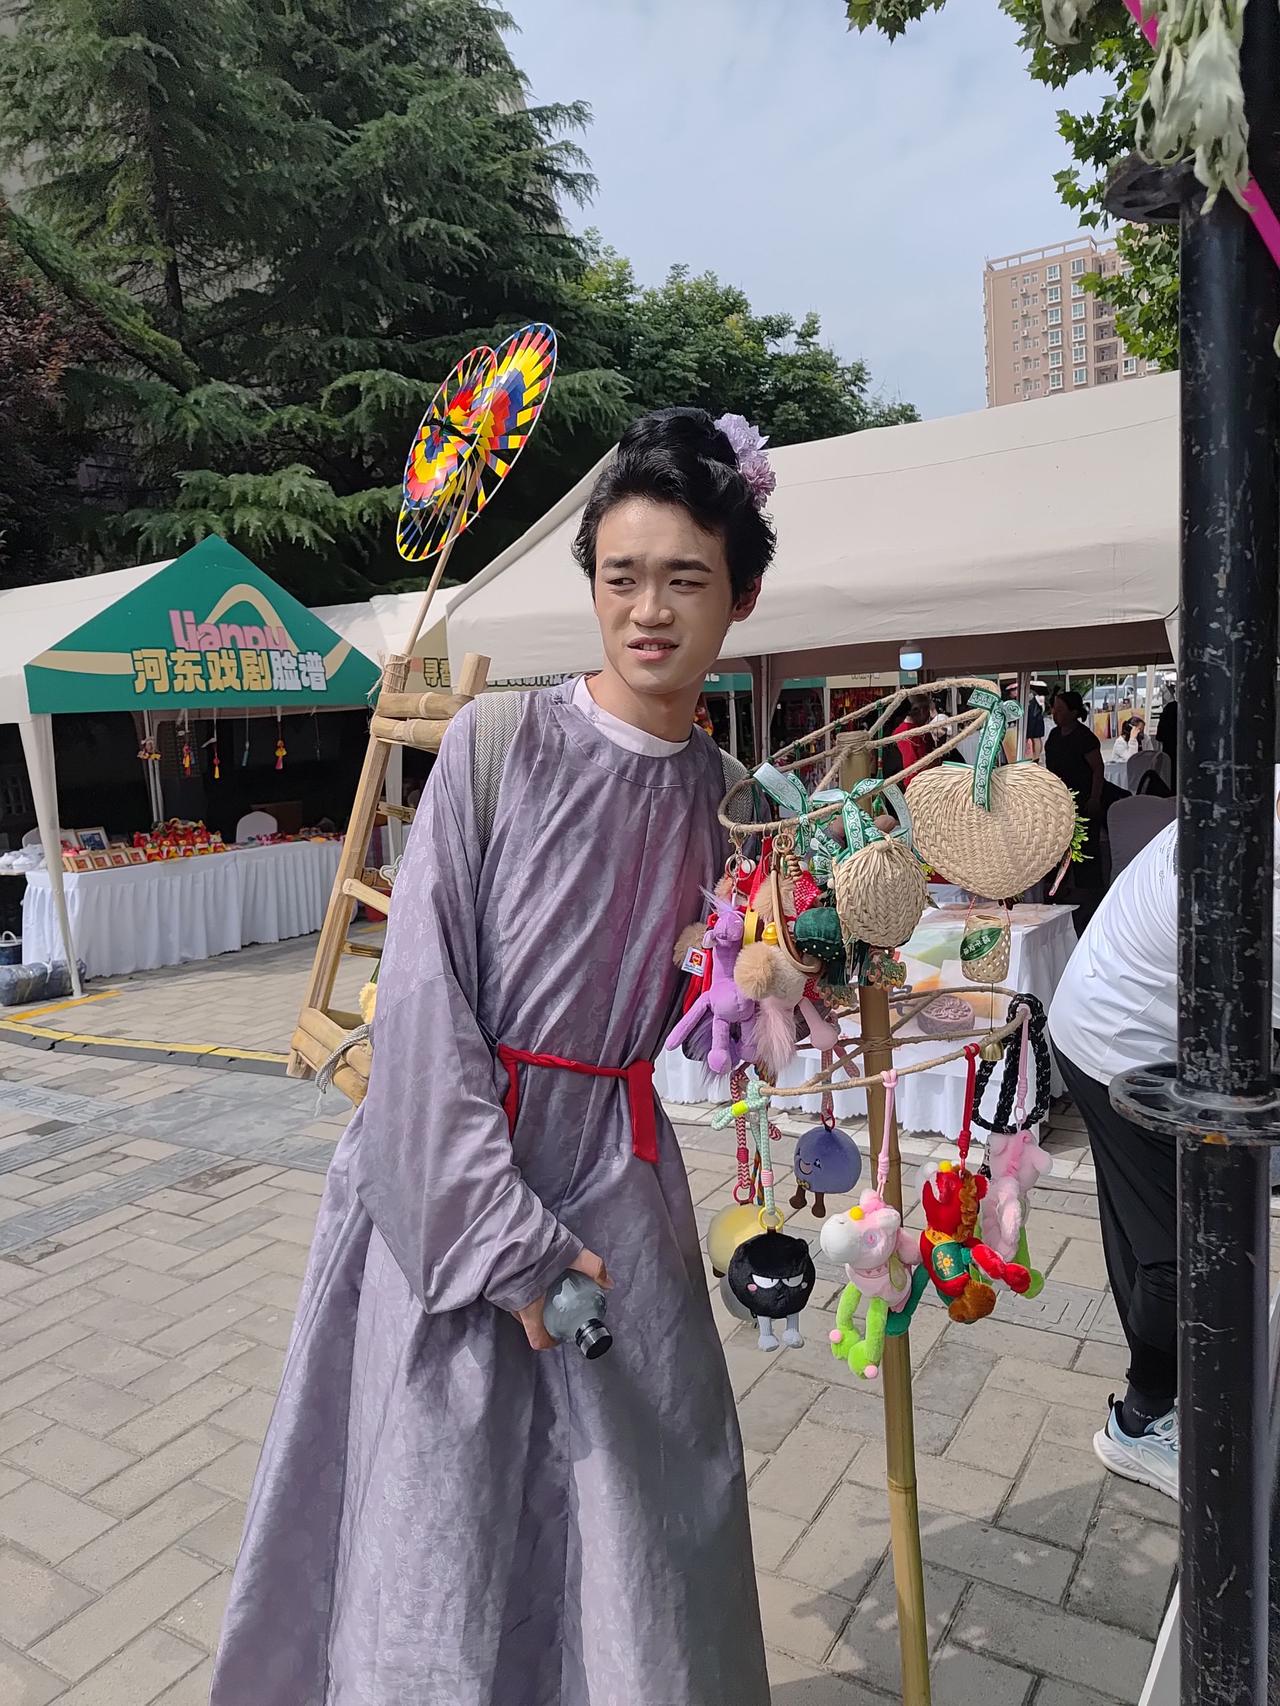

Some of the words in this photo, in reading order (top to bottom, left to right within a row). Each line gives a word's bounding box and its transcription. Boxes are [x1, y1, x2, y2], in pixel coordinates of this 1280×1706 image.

[131, 648, 328, 693] 河东戏剧脸谱
